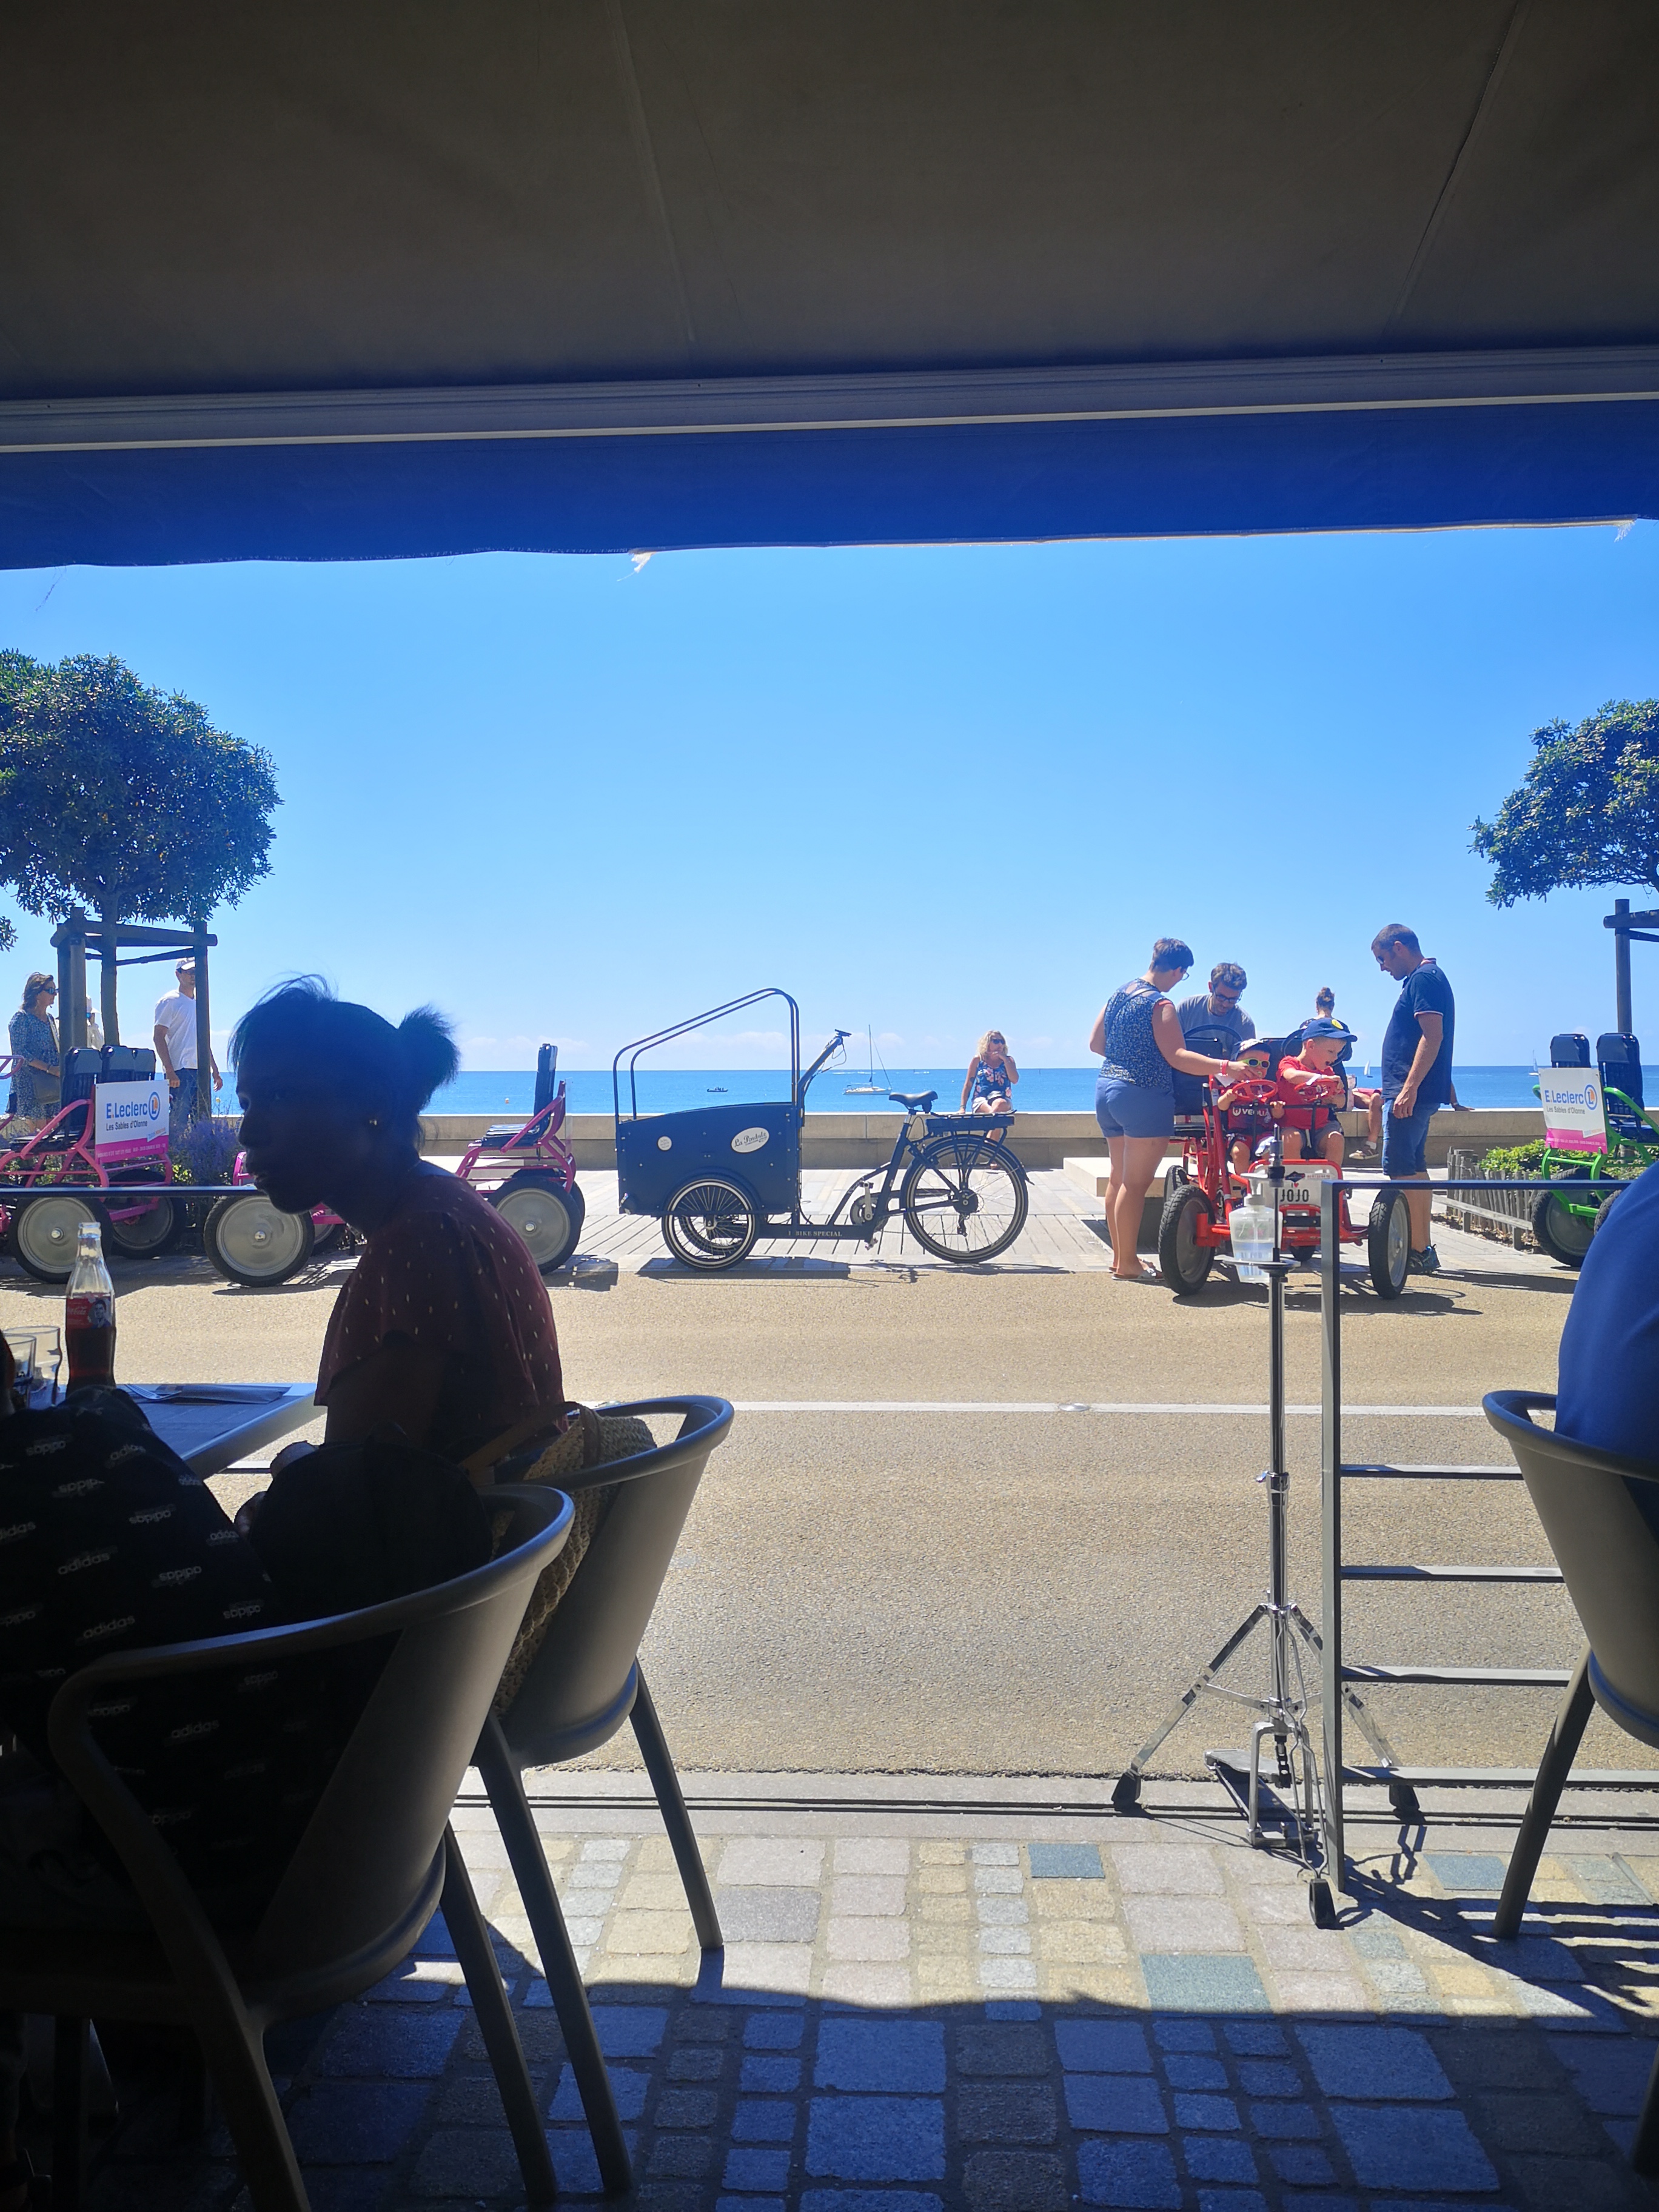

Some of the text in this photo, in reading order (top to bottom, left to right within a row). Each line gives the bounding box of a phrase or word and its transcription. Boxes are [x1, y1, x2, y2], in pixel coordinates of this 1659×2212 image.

[1544, 1090, 1584, 1104] E.Leclerc
[106, 1101, 147, 1119] E.Leclerc
[115, 1121, 129, 1130] Sables
[1280, 1189, 1309, 1202] JOJO
[58, 1552, 110, 1575] adidas
[83, 1615, 135, 1638] adidas
[171, 1720, 220, 1738] adidas
